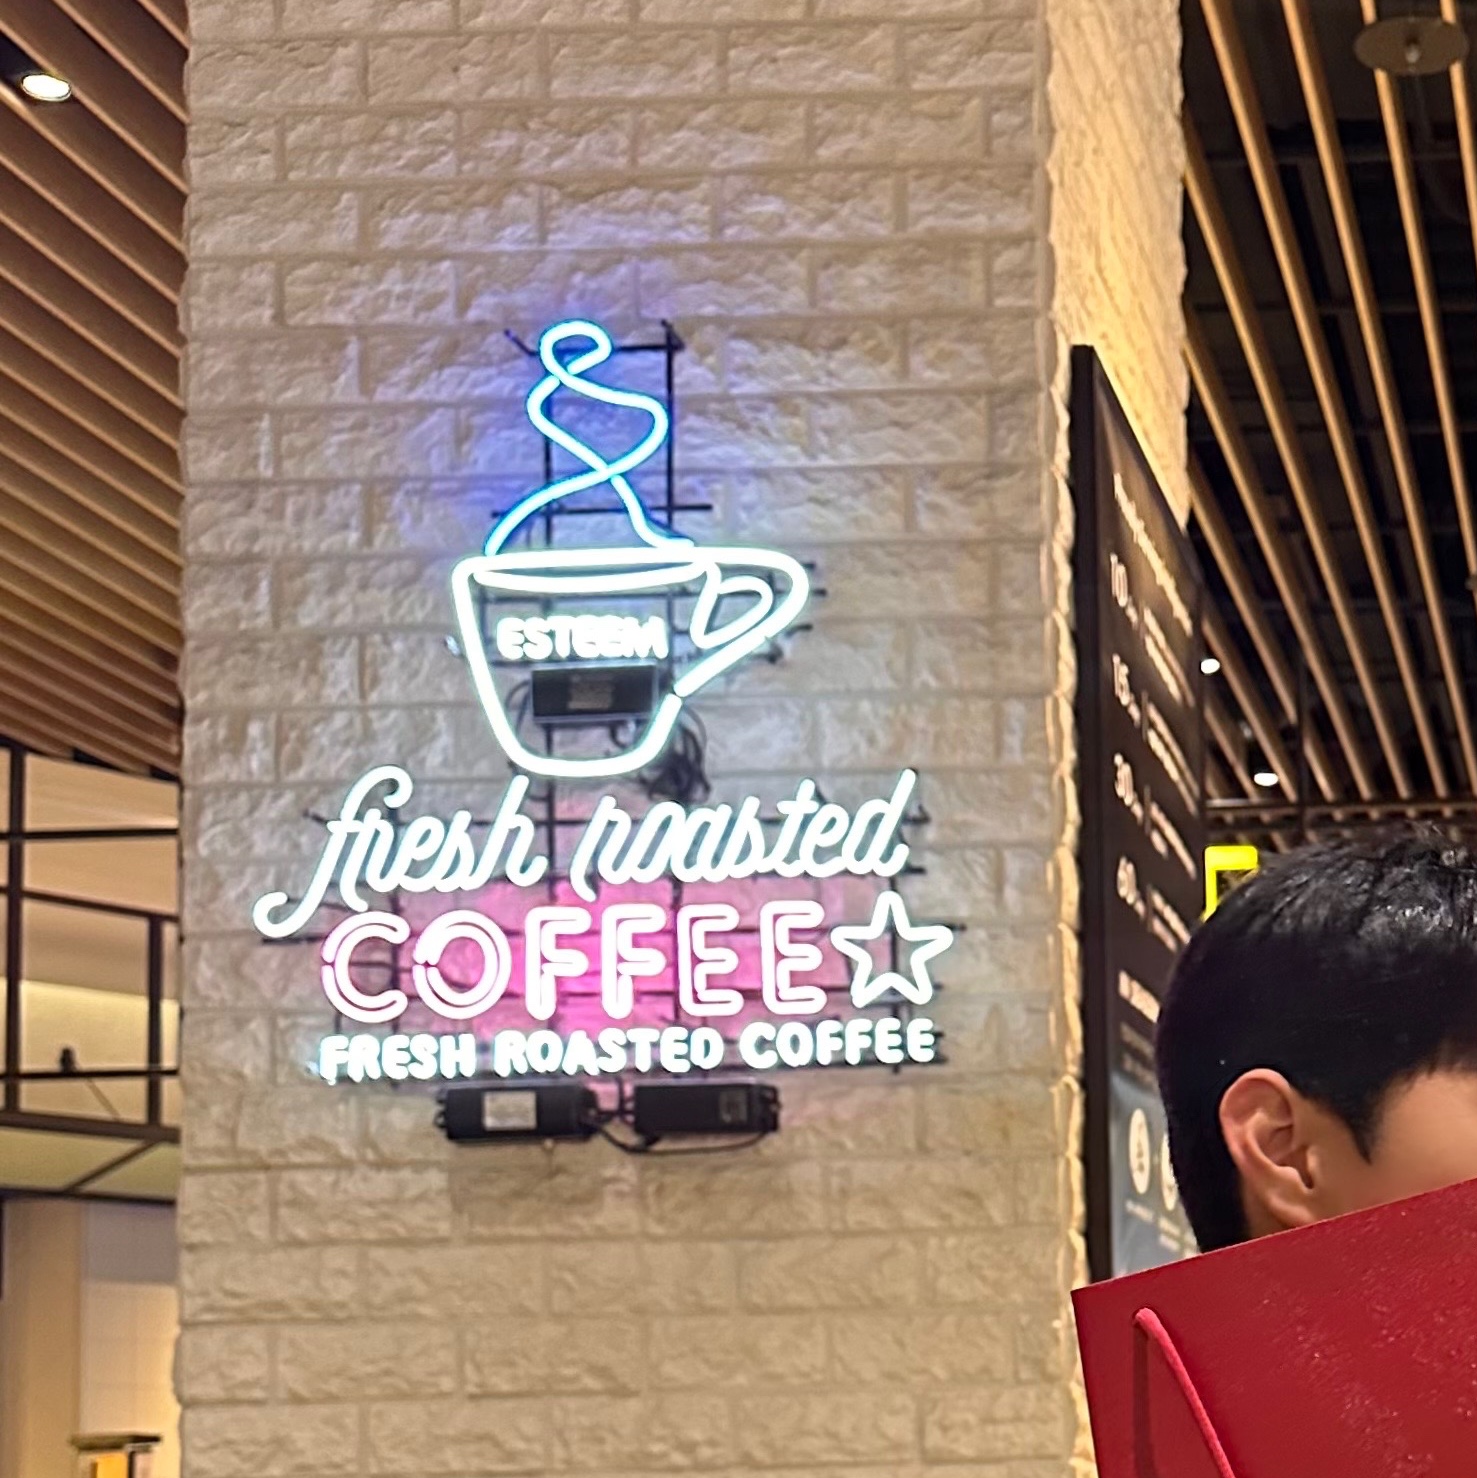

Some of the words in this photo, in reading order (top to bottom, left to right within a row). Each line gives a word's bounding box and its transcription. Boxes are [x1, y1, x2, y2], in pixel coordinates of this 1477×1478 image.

[497, 615, 669, 660] ESTEEM
[253, 765, 548, 938] fresh
[570, 768, 916, 903] roasted
[320, 899, 827, 1023] COFFEE
[317, 1032, 477, 1085] FRESH
[493, 1026, 725, 1078] ROASTED
[739, 1017, 936, 1071] COFFEE
